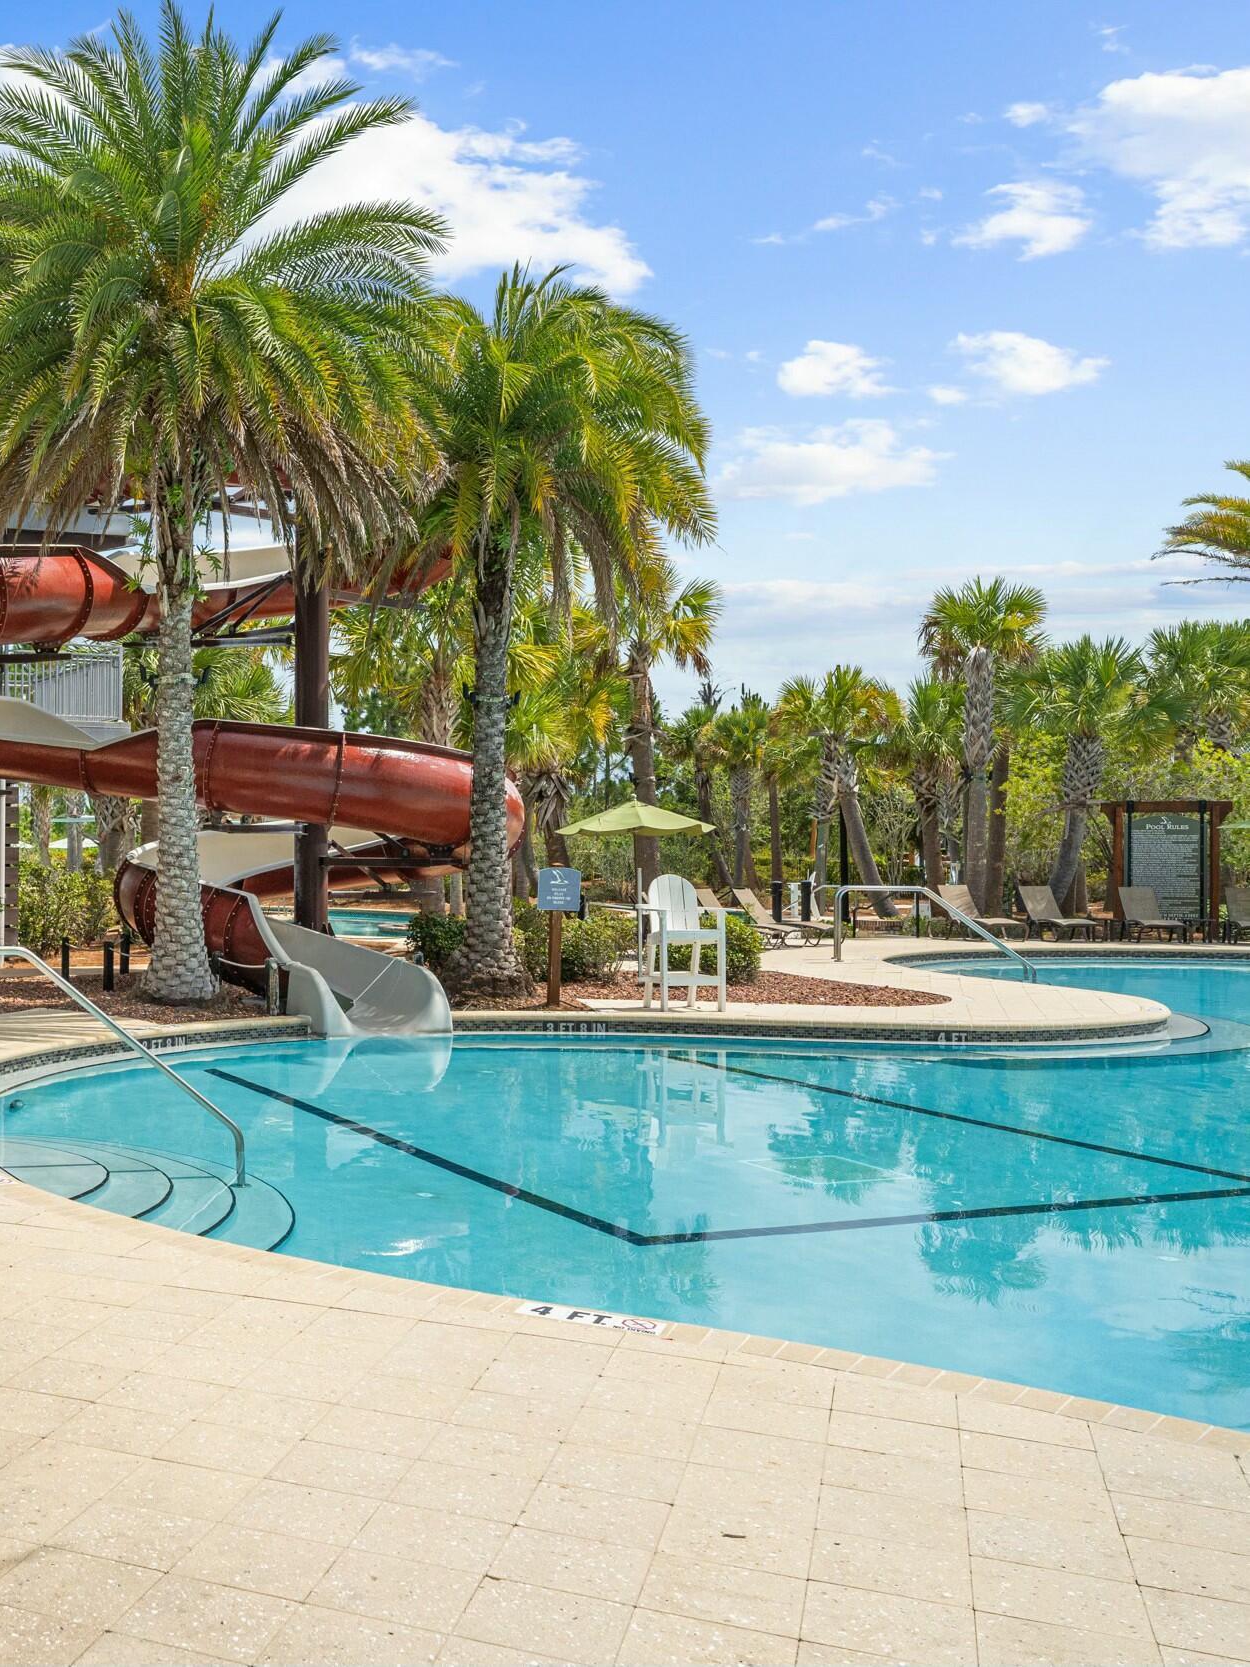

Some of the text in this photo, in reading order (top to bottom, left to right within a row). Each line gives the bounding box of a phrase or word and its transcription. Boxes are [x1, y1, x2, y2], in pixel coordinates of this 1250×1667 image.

[546, 1022, 606, 1033] 3 FT 8 IN
[151, 1039, 163, 1049] FT
[175, 1036, 186, 1047] IN
[937, 1032, 967, 1043] 4 FT
[531, 1306, 553, 1315] 4
